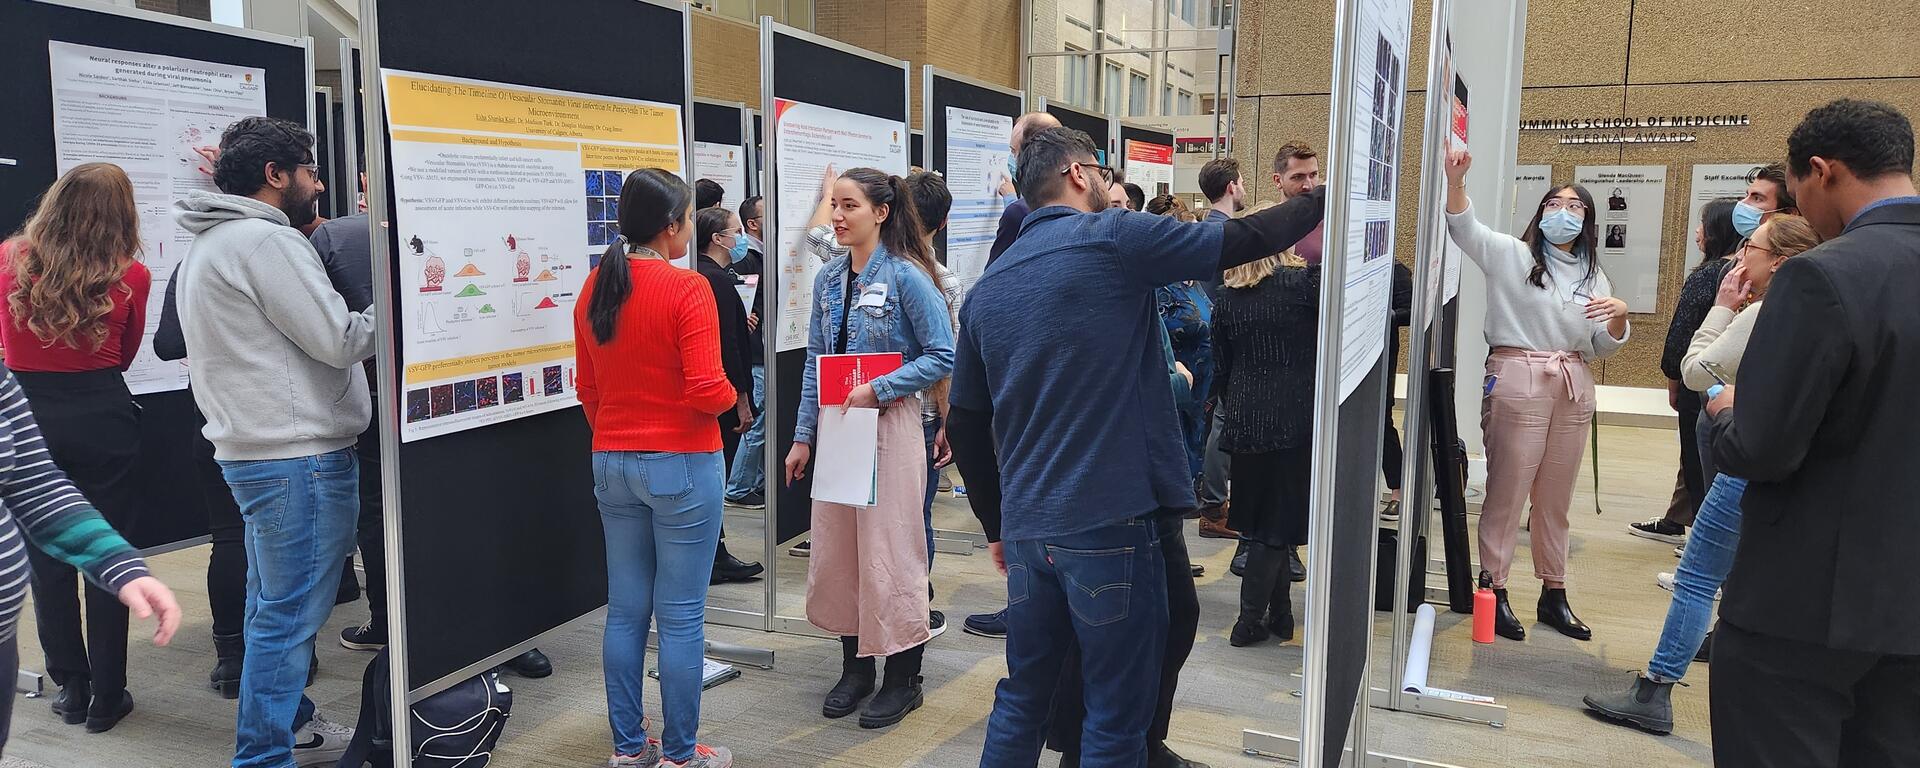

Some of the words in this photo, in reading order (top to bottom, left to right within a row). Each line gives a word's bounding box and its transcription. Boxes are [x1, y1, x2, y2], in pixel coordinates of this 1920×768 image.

[190, 69, 218, 77] neutrophil
[411, 82, 452, 96] Elucidating
[453, 86, 466, 95] The
[468, 88, 496, 98] Timeline
[499, 91, 508, 100] Of
[509, 92, 536, 103] Vesicular
[538, 96, 565, 107] Stomatitis
[567, 100, 581, 108] Virus
[582, 101, 605, 110] Infection
[650, 108, 664, 116] Tumor
[528, 108, 580, 120] Microenvironment
[1520, 120, 1578, 130] UMMING
[1585, 118, 1640, 128] SCHOOL
[1647, 117, 1665, 126] OF
[1672, 115, 1748, 126] MEDICINE
[526, 127, 546, 135] University
[462, 137, 488, 145] Background
[499, 139, 521, 147] Hypothesis
[1560, 133, 1628, 143] INTERNAL
[1635, 132, 1697, 142] AWARDS
[432, 360, 464, 372] preferentially
